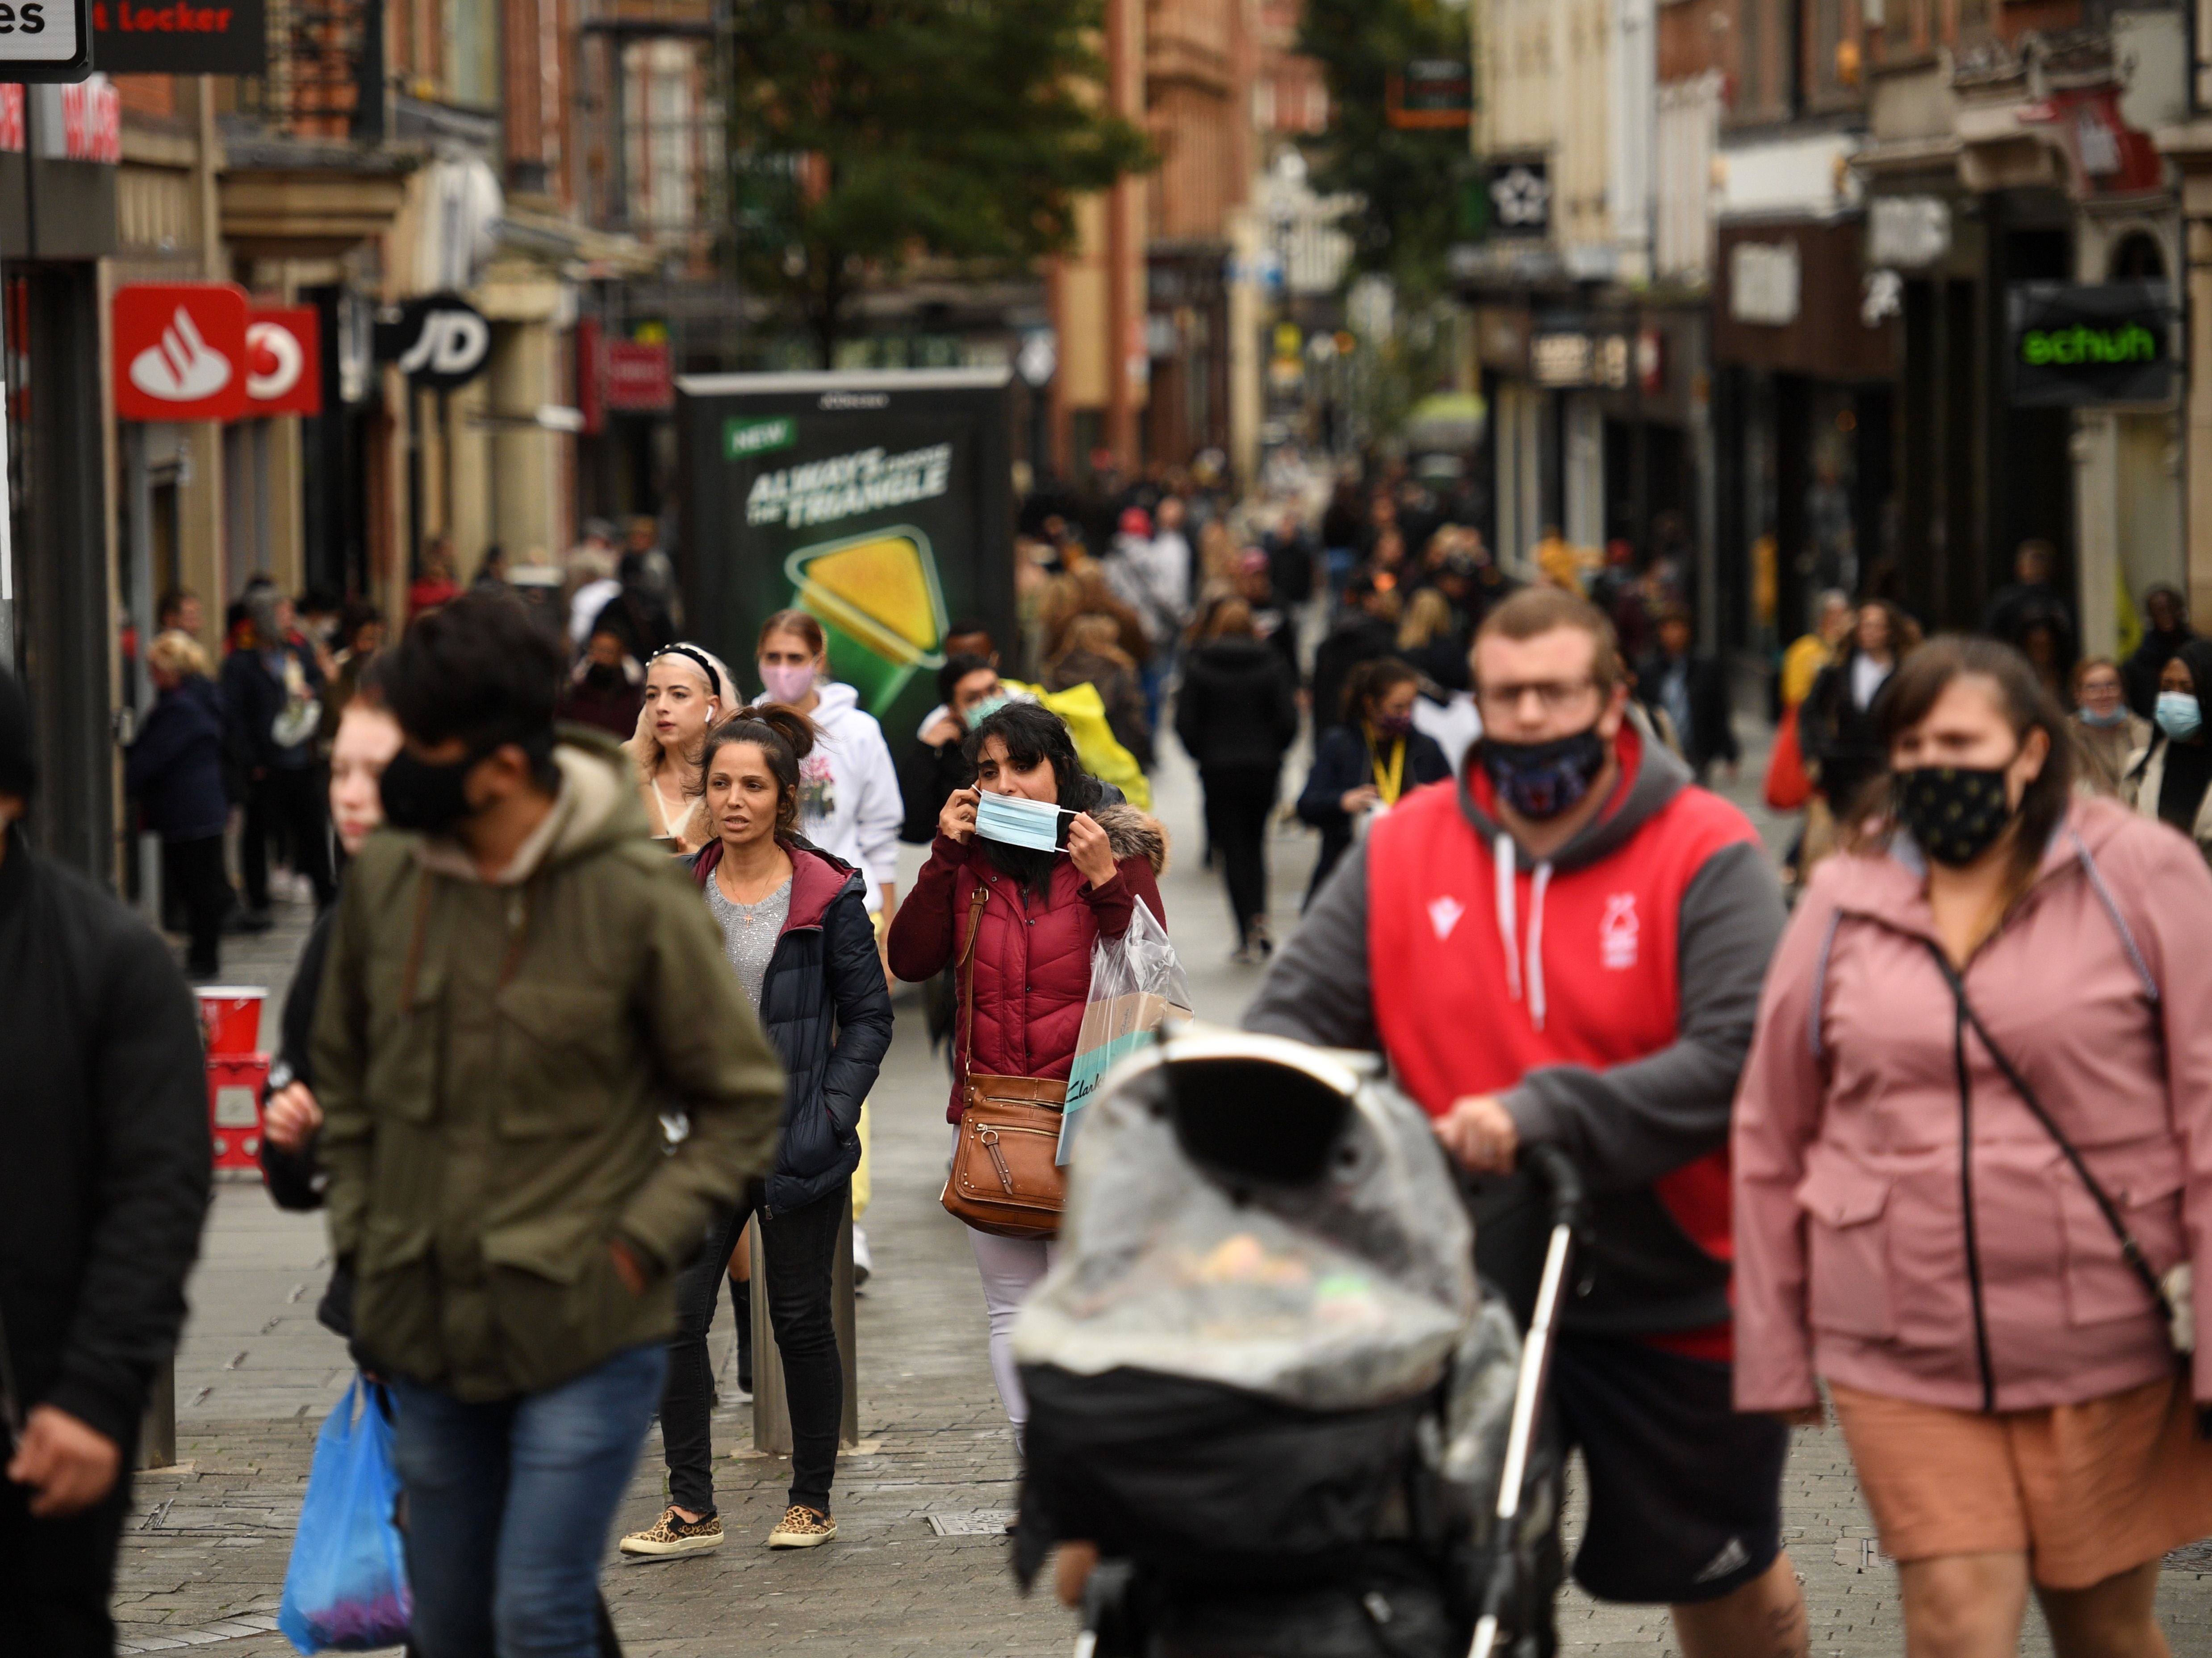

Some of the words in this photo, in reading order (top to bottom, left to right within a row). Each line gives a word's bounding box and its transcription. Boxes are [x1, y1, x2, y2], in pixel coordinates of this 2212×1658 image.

[119, 0, 233, 32] Locker
[399, 310, 489, 374] JD
[2021, 321, 2156, 365] schuh
[732, 421, 788, 451] NEW
[749, 447, 886, 501] ALWAYS
[786, 467, 949, 529] TRIANGLE
